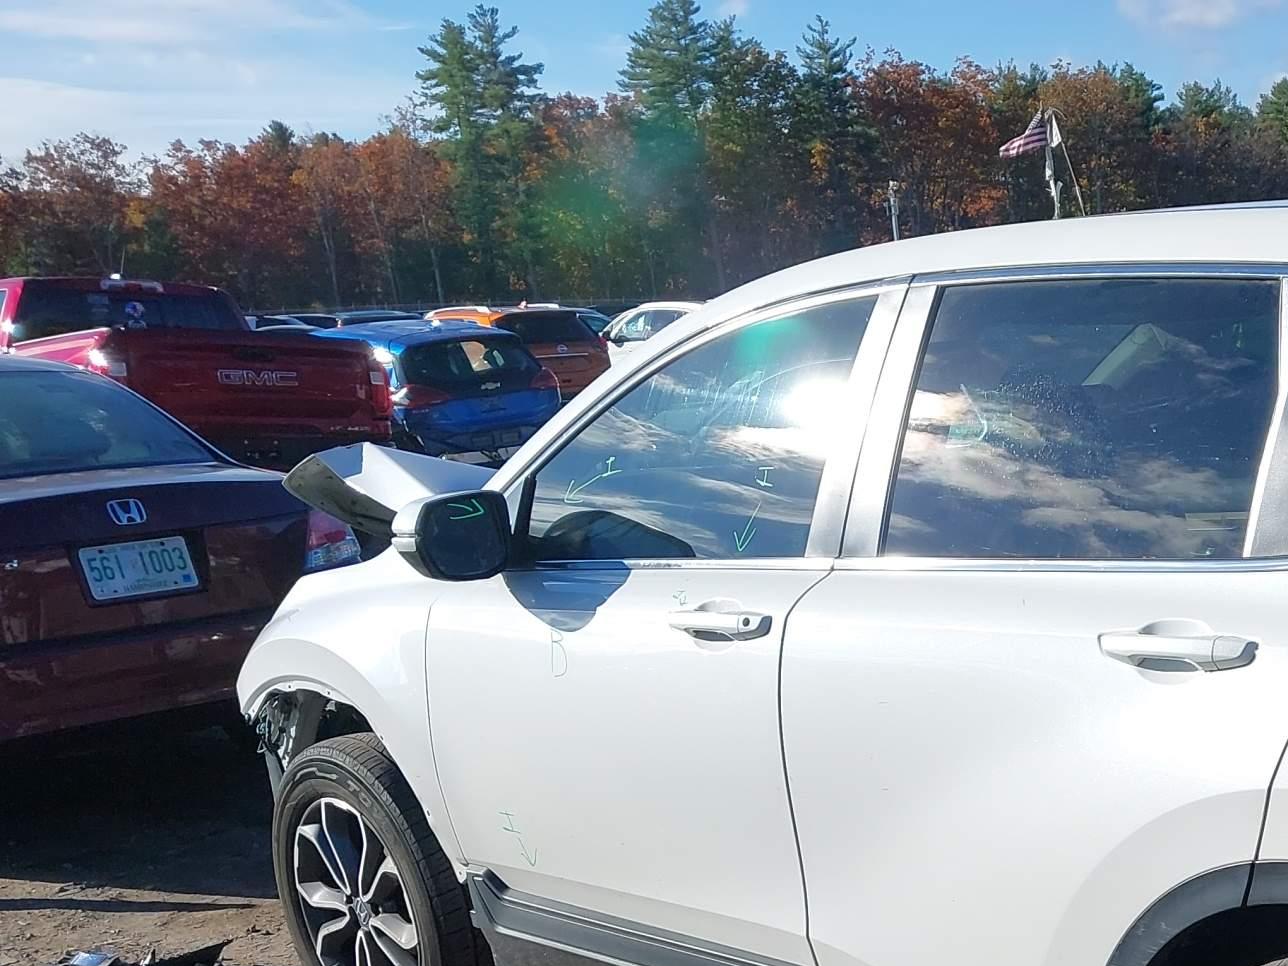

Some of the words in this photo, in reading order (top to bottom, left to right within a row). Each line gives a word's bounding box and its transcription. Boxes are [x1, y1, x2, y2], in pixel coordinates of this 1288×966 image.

[217, 369, 299, 386] GMC
[86, 554, 125, 582] 561
[138, 546, 188, 575] 1003
